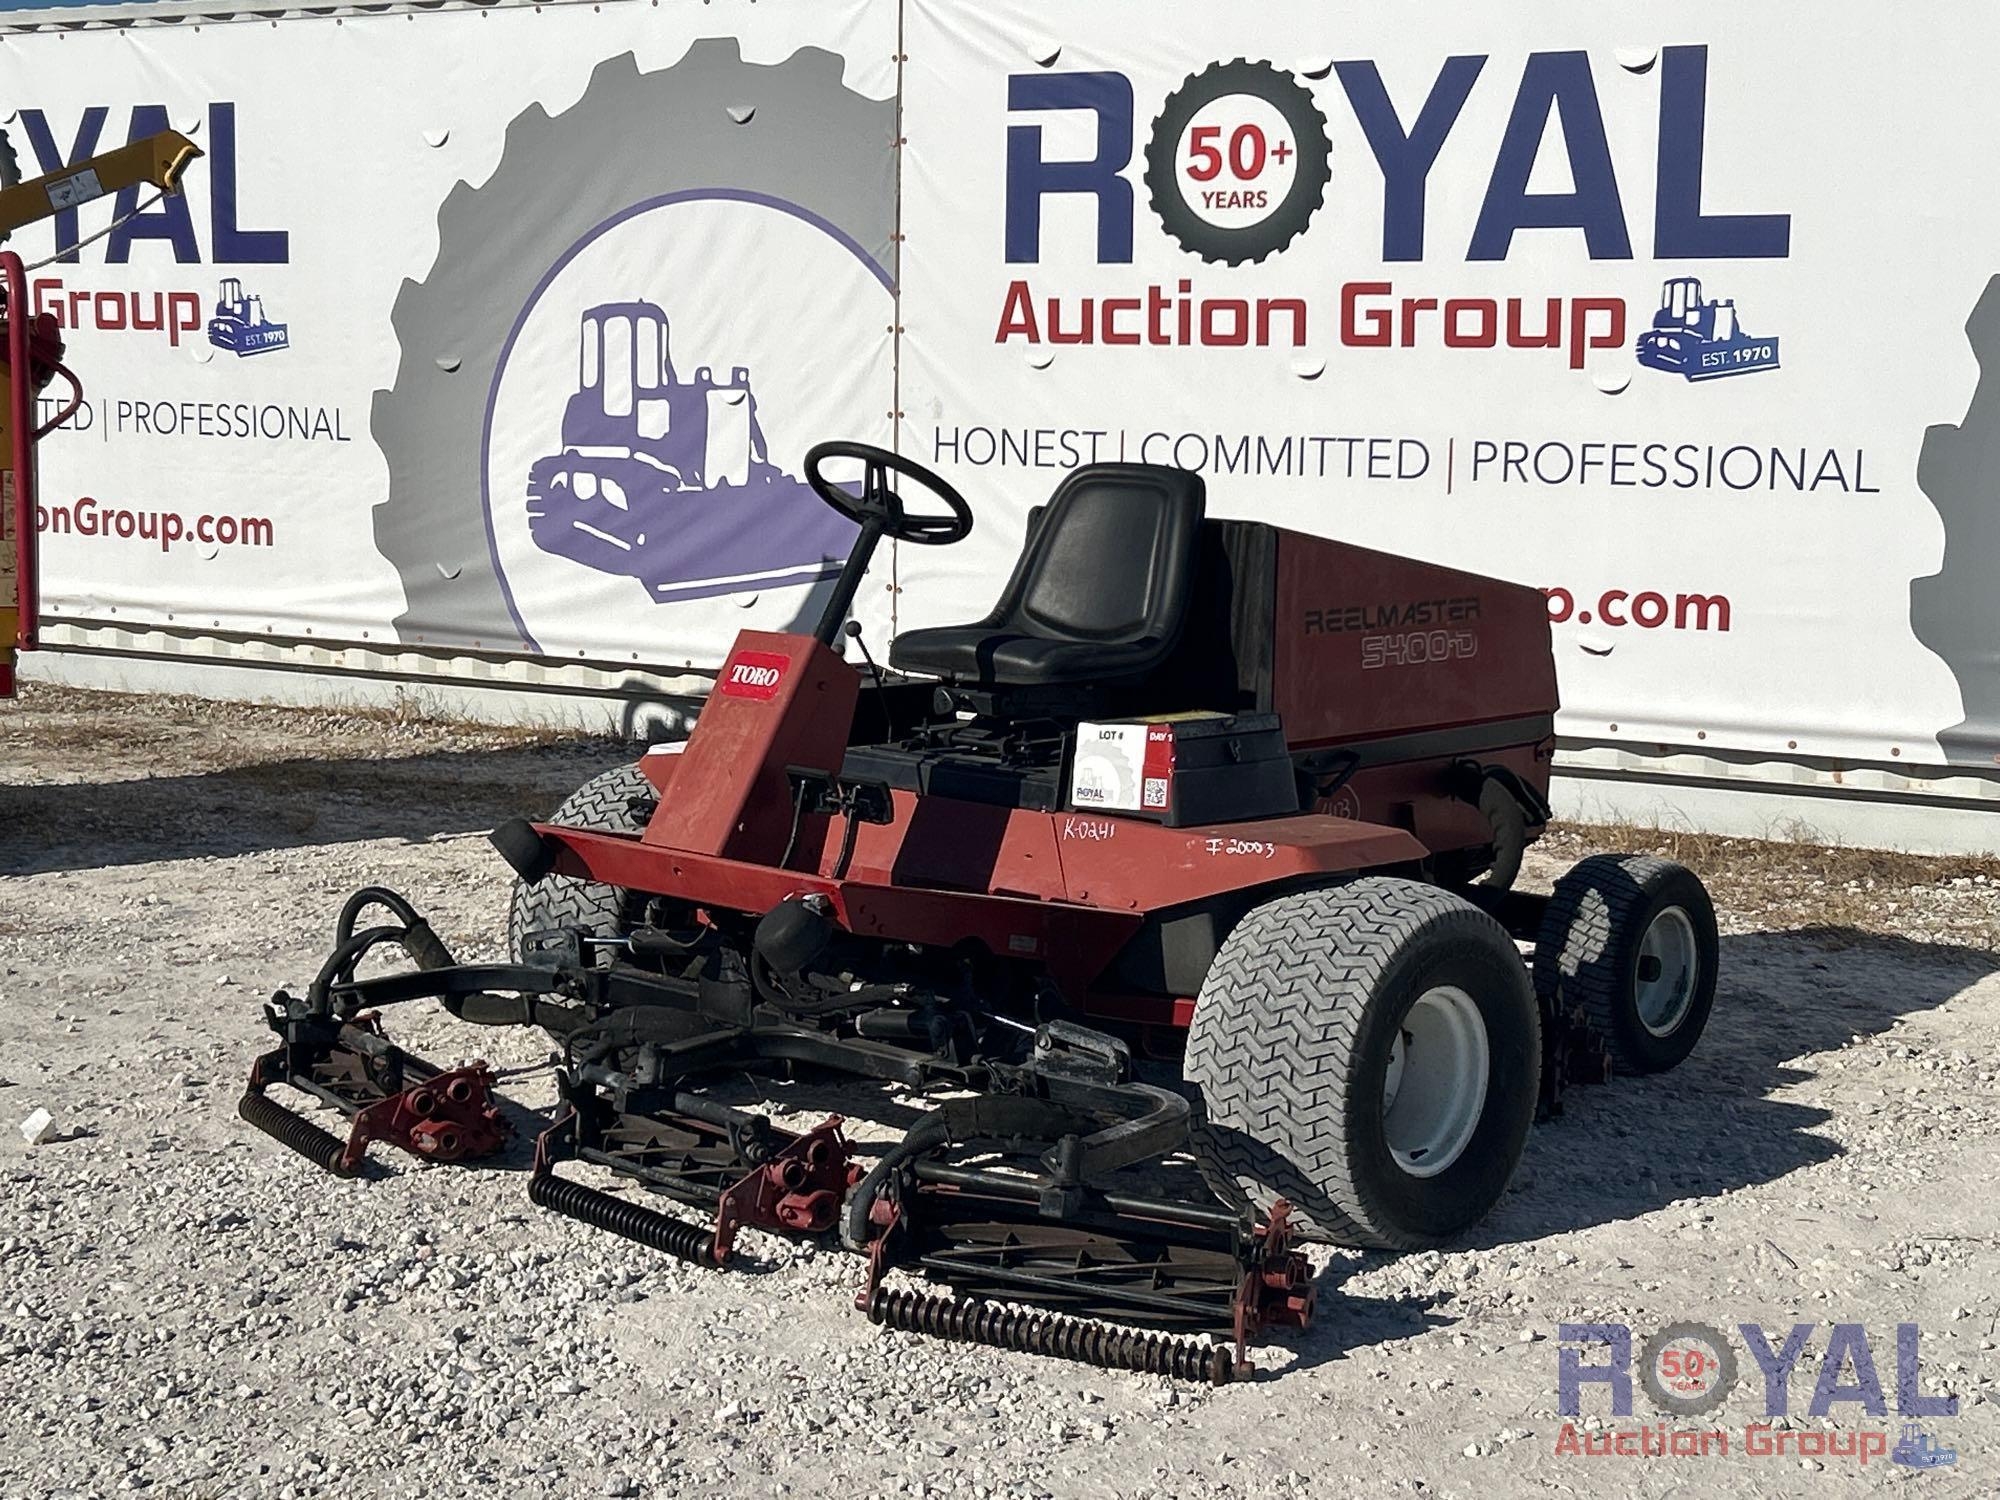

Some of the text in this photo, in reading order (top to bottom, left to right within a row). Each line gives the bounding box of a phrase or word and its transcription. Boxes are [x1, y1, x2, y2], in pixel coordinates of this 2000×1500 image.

[1005, 44, 1791, 266] ROYAL
[1186, 124, 1293, 181] 50+
[0, 102, 289, 263] YAL
[1201, 190, 1268, 209] YEARS
[33, 279, 201, 347] Group
[995, 279, 1626, 369] Auction Group
[263, 330, 285, 343] 1970
[1702, 346, 1771, 367] EST. 1970
[118, 401, 351, 441] PROFESSIONAL
[934, 426, 1881, 493] HONEST COMMITTED PROFESSIONAL
[37, 498, 273, 551] onGroup.com
[1305, 597, 1481, 634] REELMASTER
[730, 664, 780, 687] TORO
[1099, 730, 1117, 740] LOT
[1150, 732, 1167, 742] DAY
[1063, 817, 1115, 841] K-0241
